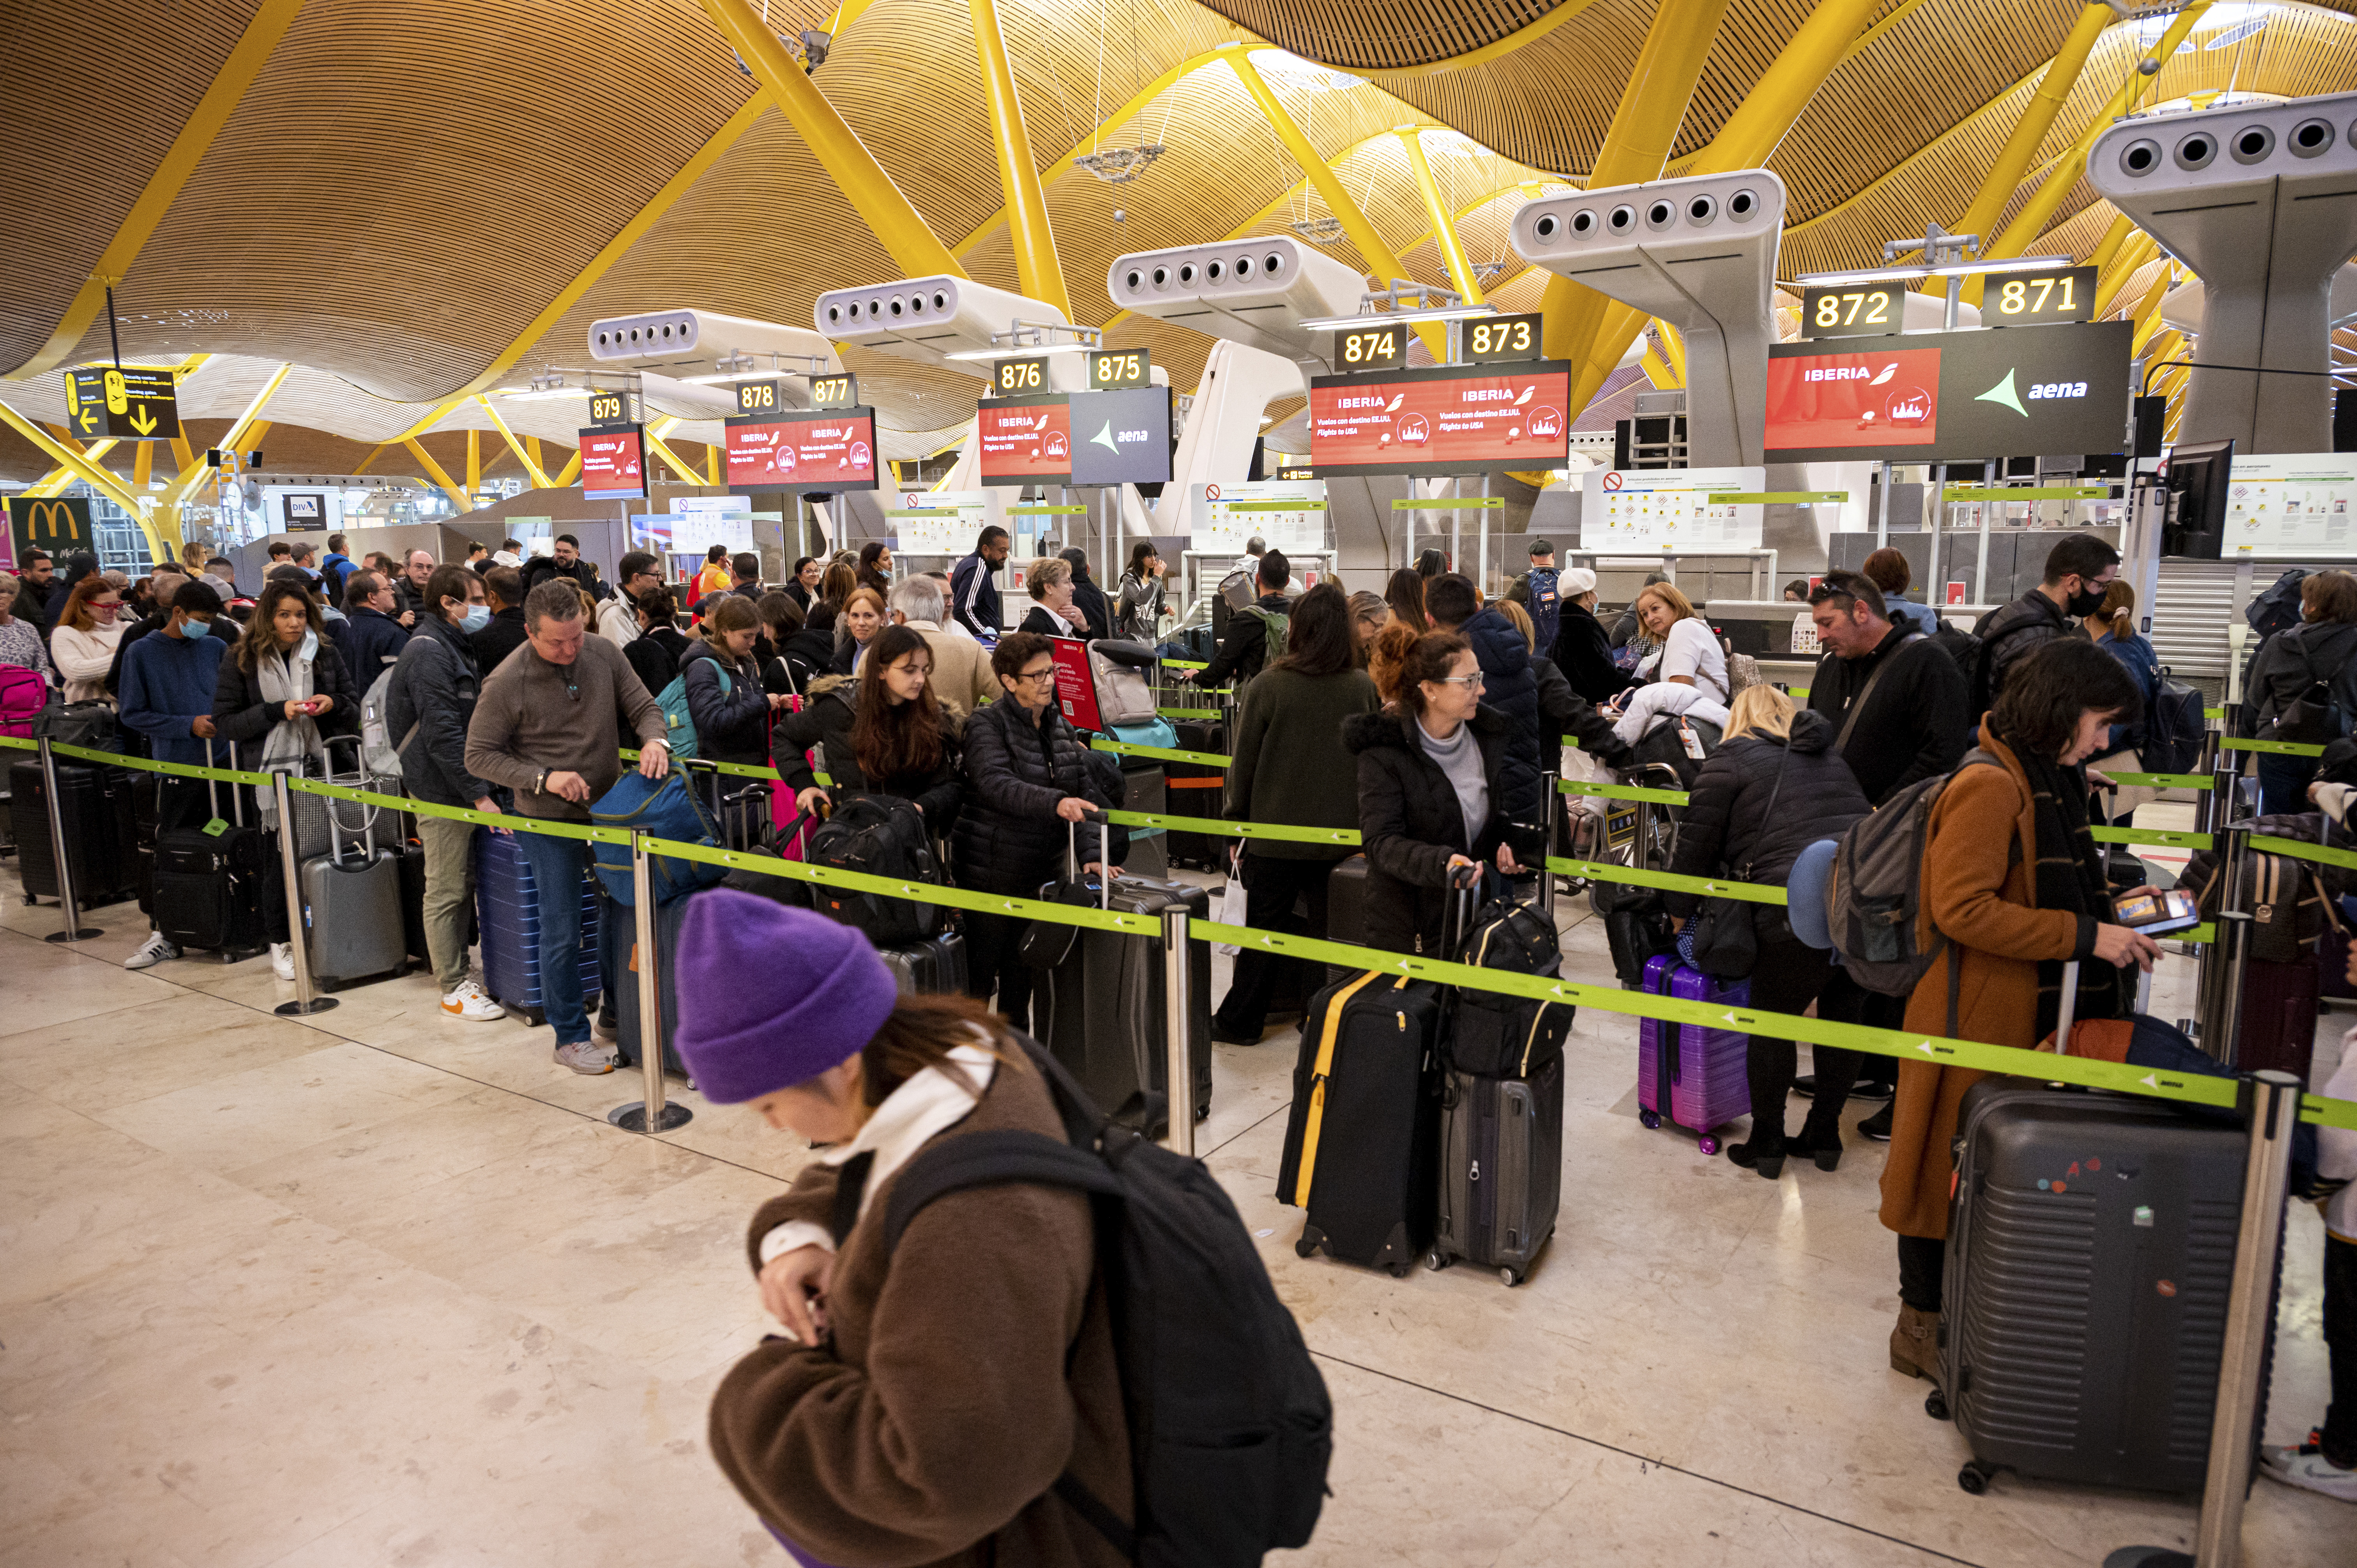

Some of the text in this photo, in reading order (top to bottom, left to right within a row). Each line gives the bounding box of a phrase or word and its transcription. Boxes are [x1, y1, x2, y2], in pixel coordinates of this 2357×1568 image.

[1999, 276, 2077, 314] 871
[1815, 291, 1889, 327] 872
[1472, 321, 1531, 354] 873
[1345, 332, 1396, 362] 874
[1001, 363, 1041, 389] 876
[1098, 355, 1140, 382] 875
[1804, 366, 1870, 382] IBERIA
[742, 385, 773, 408] 878
[815, 378, 848, 403] 877
[1463, 388, 1514, 402] IBERIA
[2028, 381, 2087, 399] aena
[594, 398, 620, 419] 879
[1338, 396, 1385, 409] IBERIA
[1371, 415, 1391, 423] EE.UU.
[1498, 408, 1520, 417] EE.UU.
[998, 417, 1034, 427] IBERIA
[1439, 423, 1461, 432] Flights
[741, 433, 769, 442] IBERIA
[812, 429, 842, 438] IBERIA
[1117, 430, 1148, 443] aena
[1317, 429, 1337, 438] Flights
[593, 443, 616, 451] IBERIA
